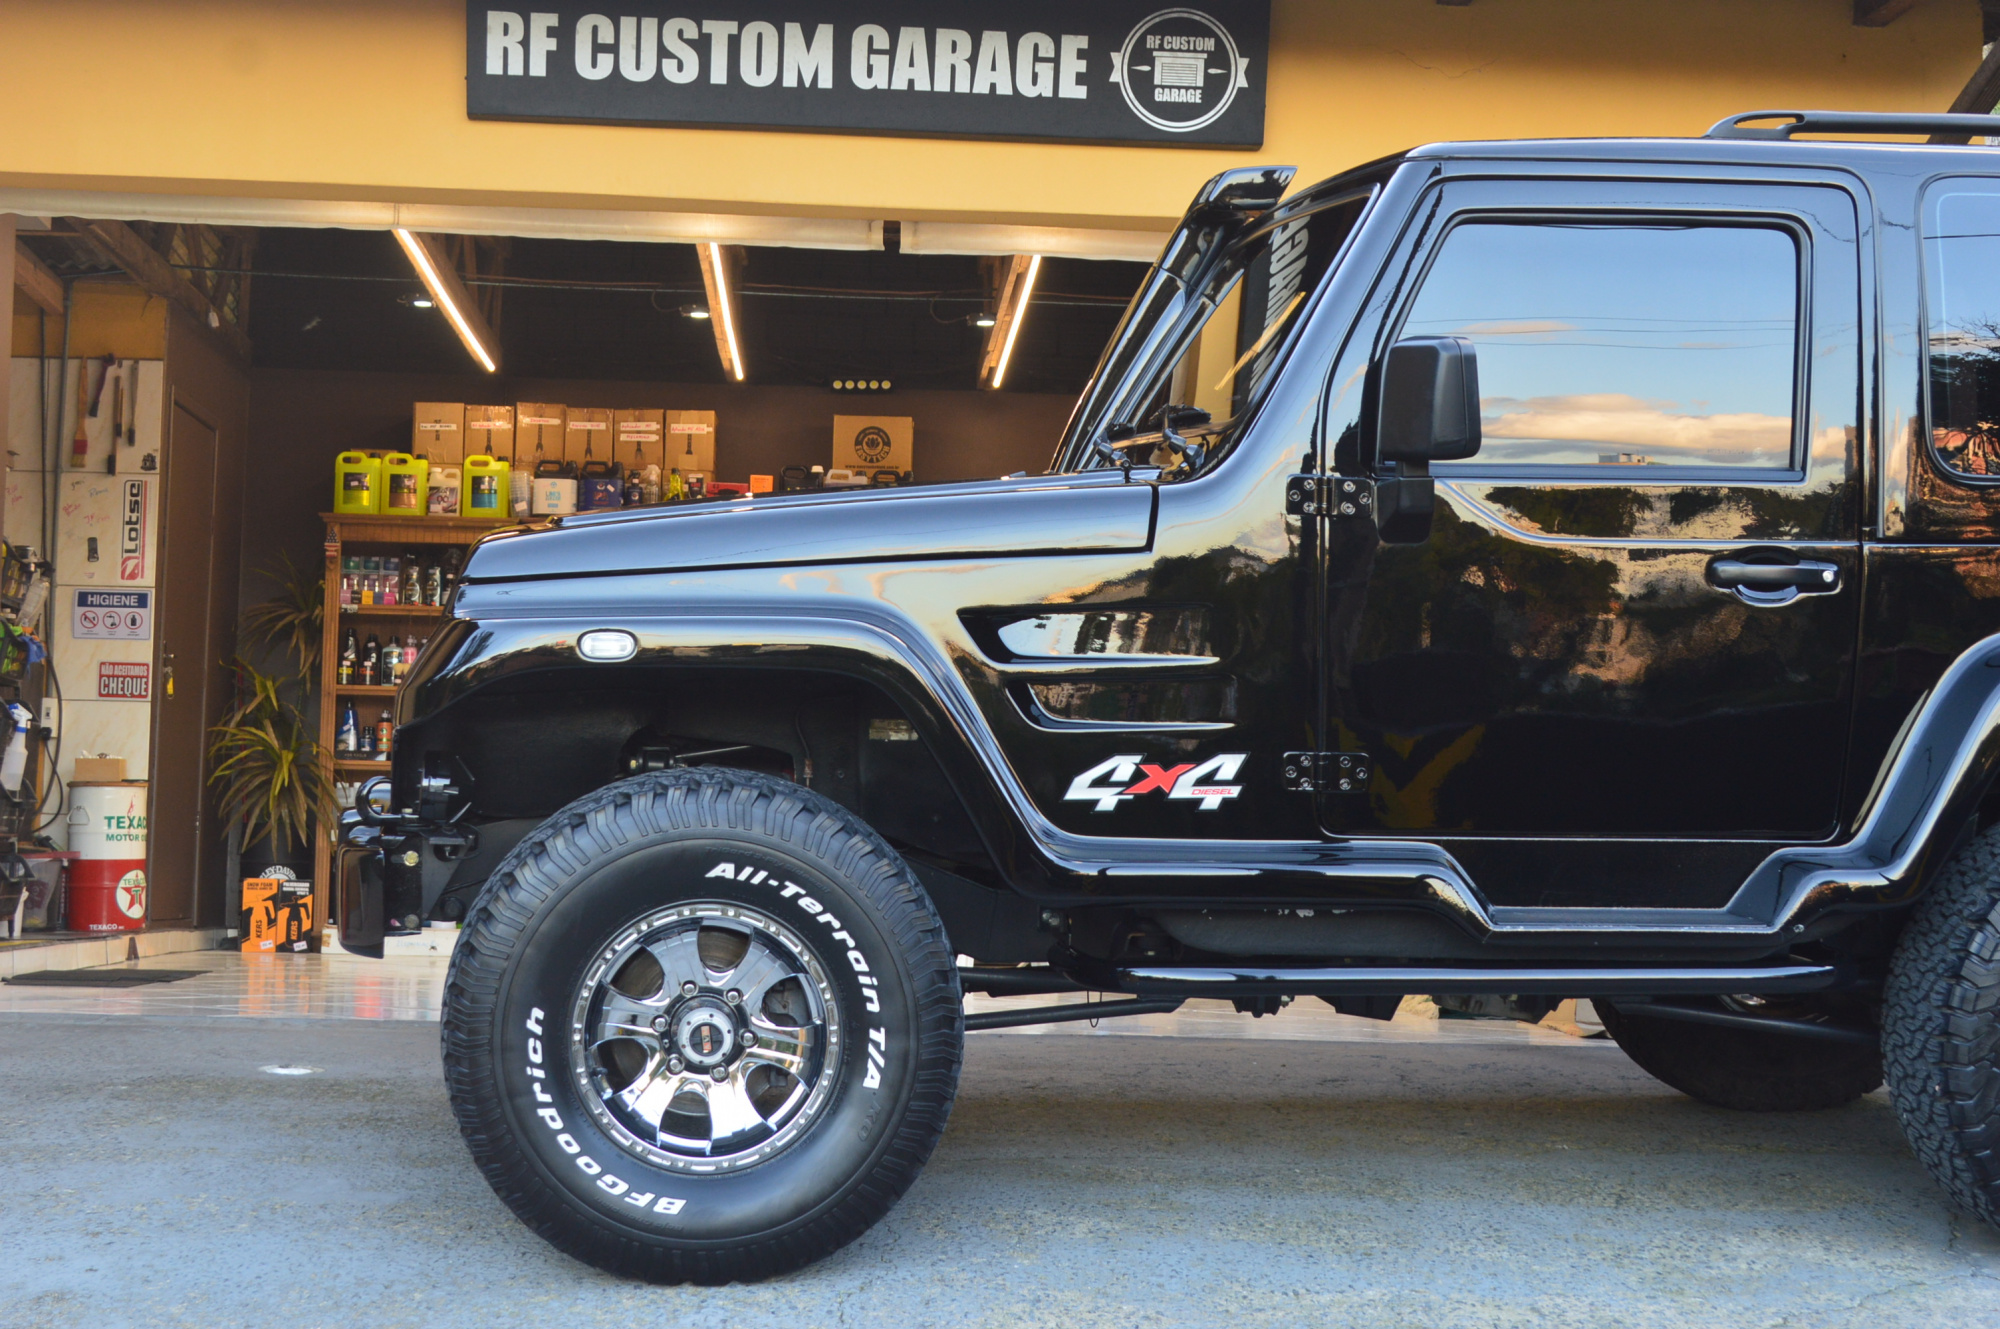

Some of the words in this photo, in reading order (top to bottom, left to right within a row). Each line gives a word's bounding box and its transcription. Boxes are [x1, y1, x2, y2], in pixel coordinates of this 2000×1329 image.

[1146, 34, 1162, 49] RF
[1163, 35, 1215, 51] CUSTOM
[486, 10, 559, 77] RF
[574, 14, 834, 89] CUSTOM
[850, 24, 1089, 99] GARAGE
[1154, 87, 1202, 103] GARAGE
[855, 445, 890, 463] EASYTECH
[124, 482, 141, 554] Lotse
[87, 594, 139, 606] HIGIENE
[101, 663, 114, 675] NÃO
[114, 665, 147, 676] ACEITAMOS
[101, 677, 148, 697] CHEQUE
[1191, 788, 1234, 796] DIESEL
[106, 834, 140, 842] MOTOR
[132, 889, 141, 904] T
[89, 923, 118, 931] TEXACO
[255, 920, 263, 938] KERS
[290, 921, 299, 940] KERS
[704, 862, 880, 1013] All-Terrain
[862, 1026, 886, 1090] T/A
[525, 1007, 687, 1215] BFGoodrich
